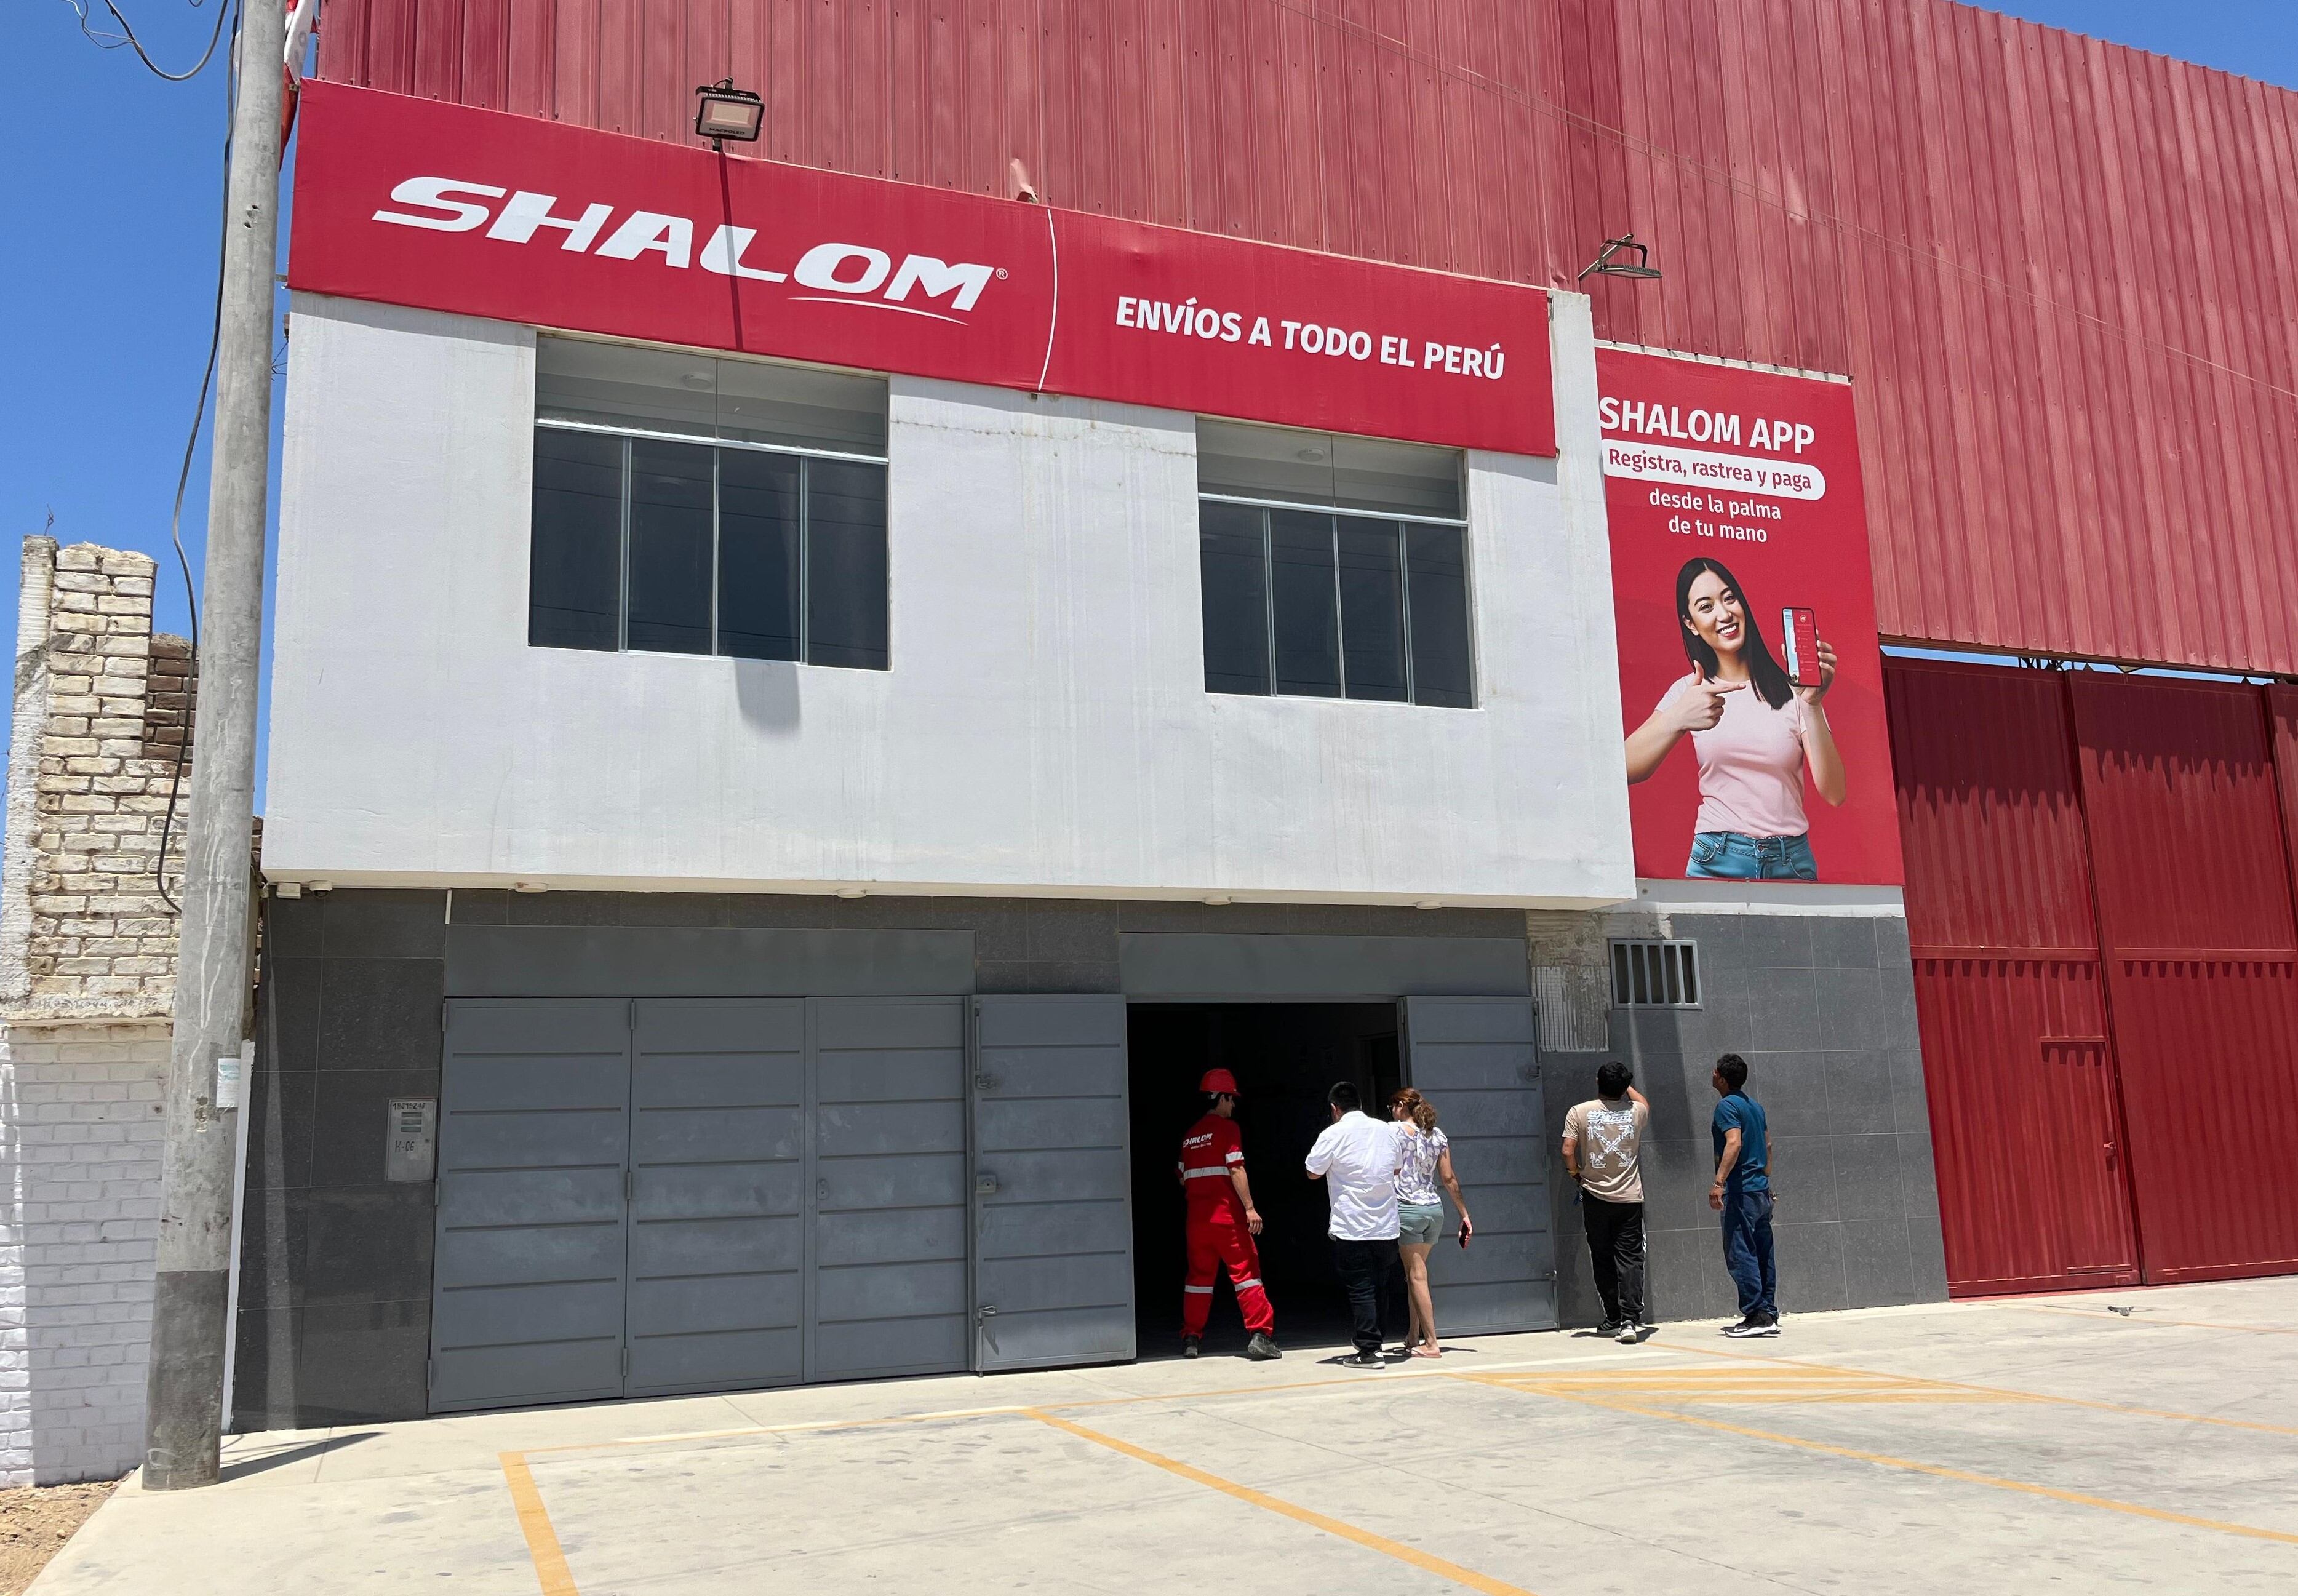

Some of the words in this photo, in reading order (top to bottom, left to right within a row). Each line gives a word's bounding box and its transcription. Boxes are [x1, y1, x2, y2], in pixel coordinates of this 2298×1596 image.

[372, 176, 995, 311] SHALOM
[1115, 296, 1242, 342] ENVÍOS
[1248, 317, 1272, 347] A
[1280, 320, 1372, 361] TODO
[1380, 335, 1415, 367] EL
[1424, 342, 1505, 380] PERÚ
[1599, 396, 1741, 447] SHALOM
[1749, 418, 1815, 454] APP
[1609, 448, 1688, 477] Registra,
[1692, 461, 1753, 482] rastrea
[1757, 471, 1768, 487] y
[1772, 471, 1812, 492] paga
[1649, 488, 1703, 511] desde
[1707, 493, 1724, 513] la
[1729, 499, 1782, 520] palma
[1668, 515, 1691, 535] de
[1695, 519, 1714, 537] tu
[1719, 524, 1768, 543] mano
